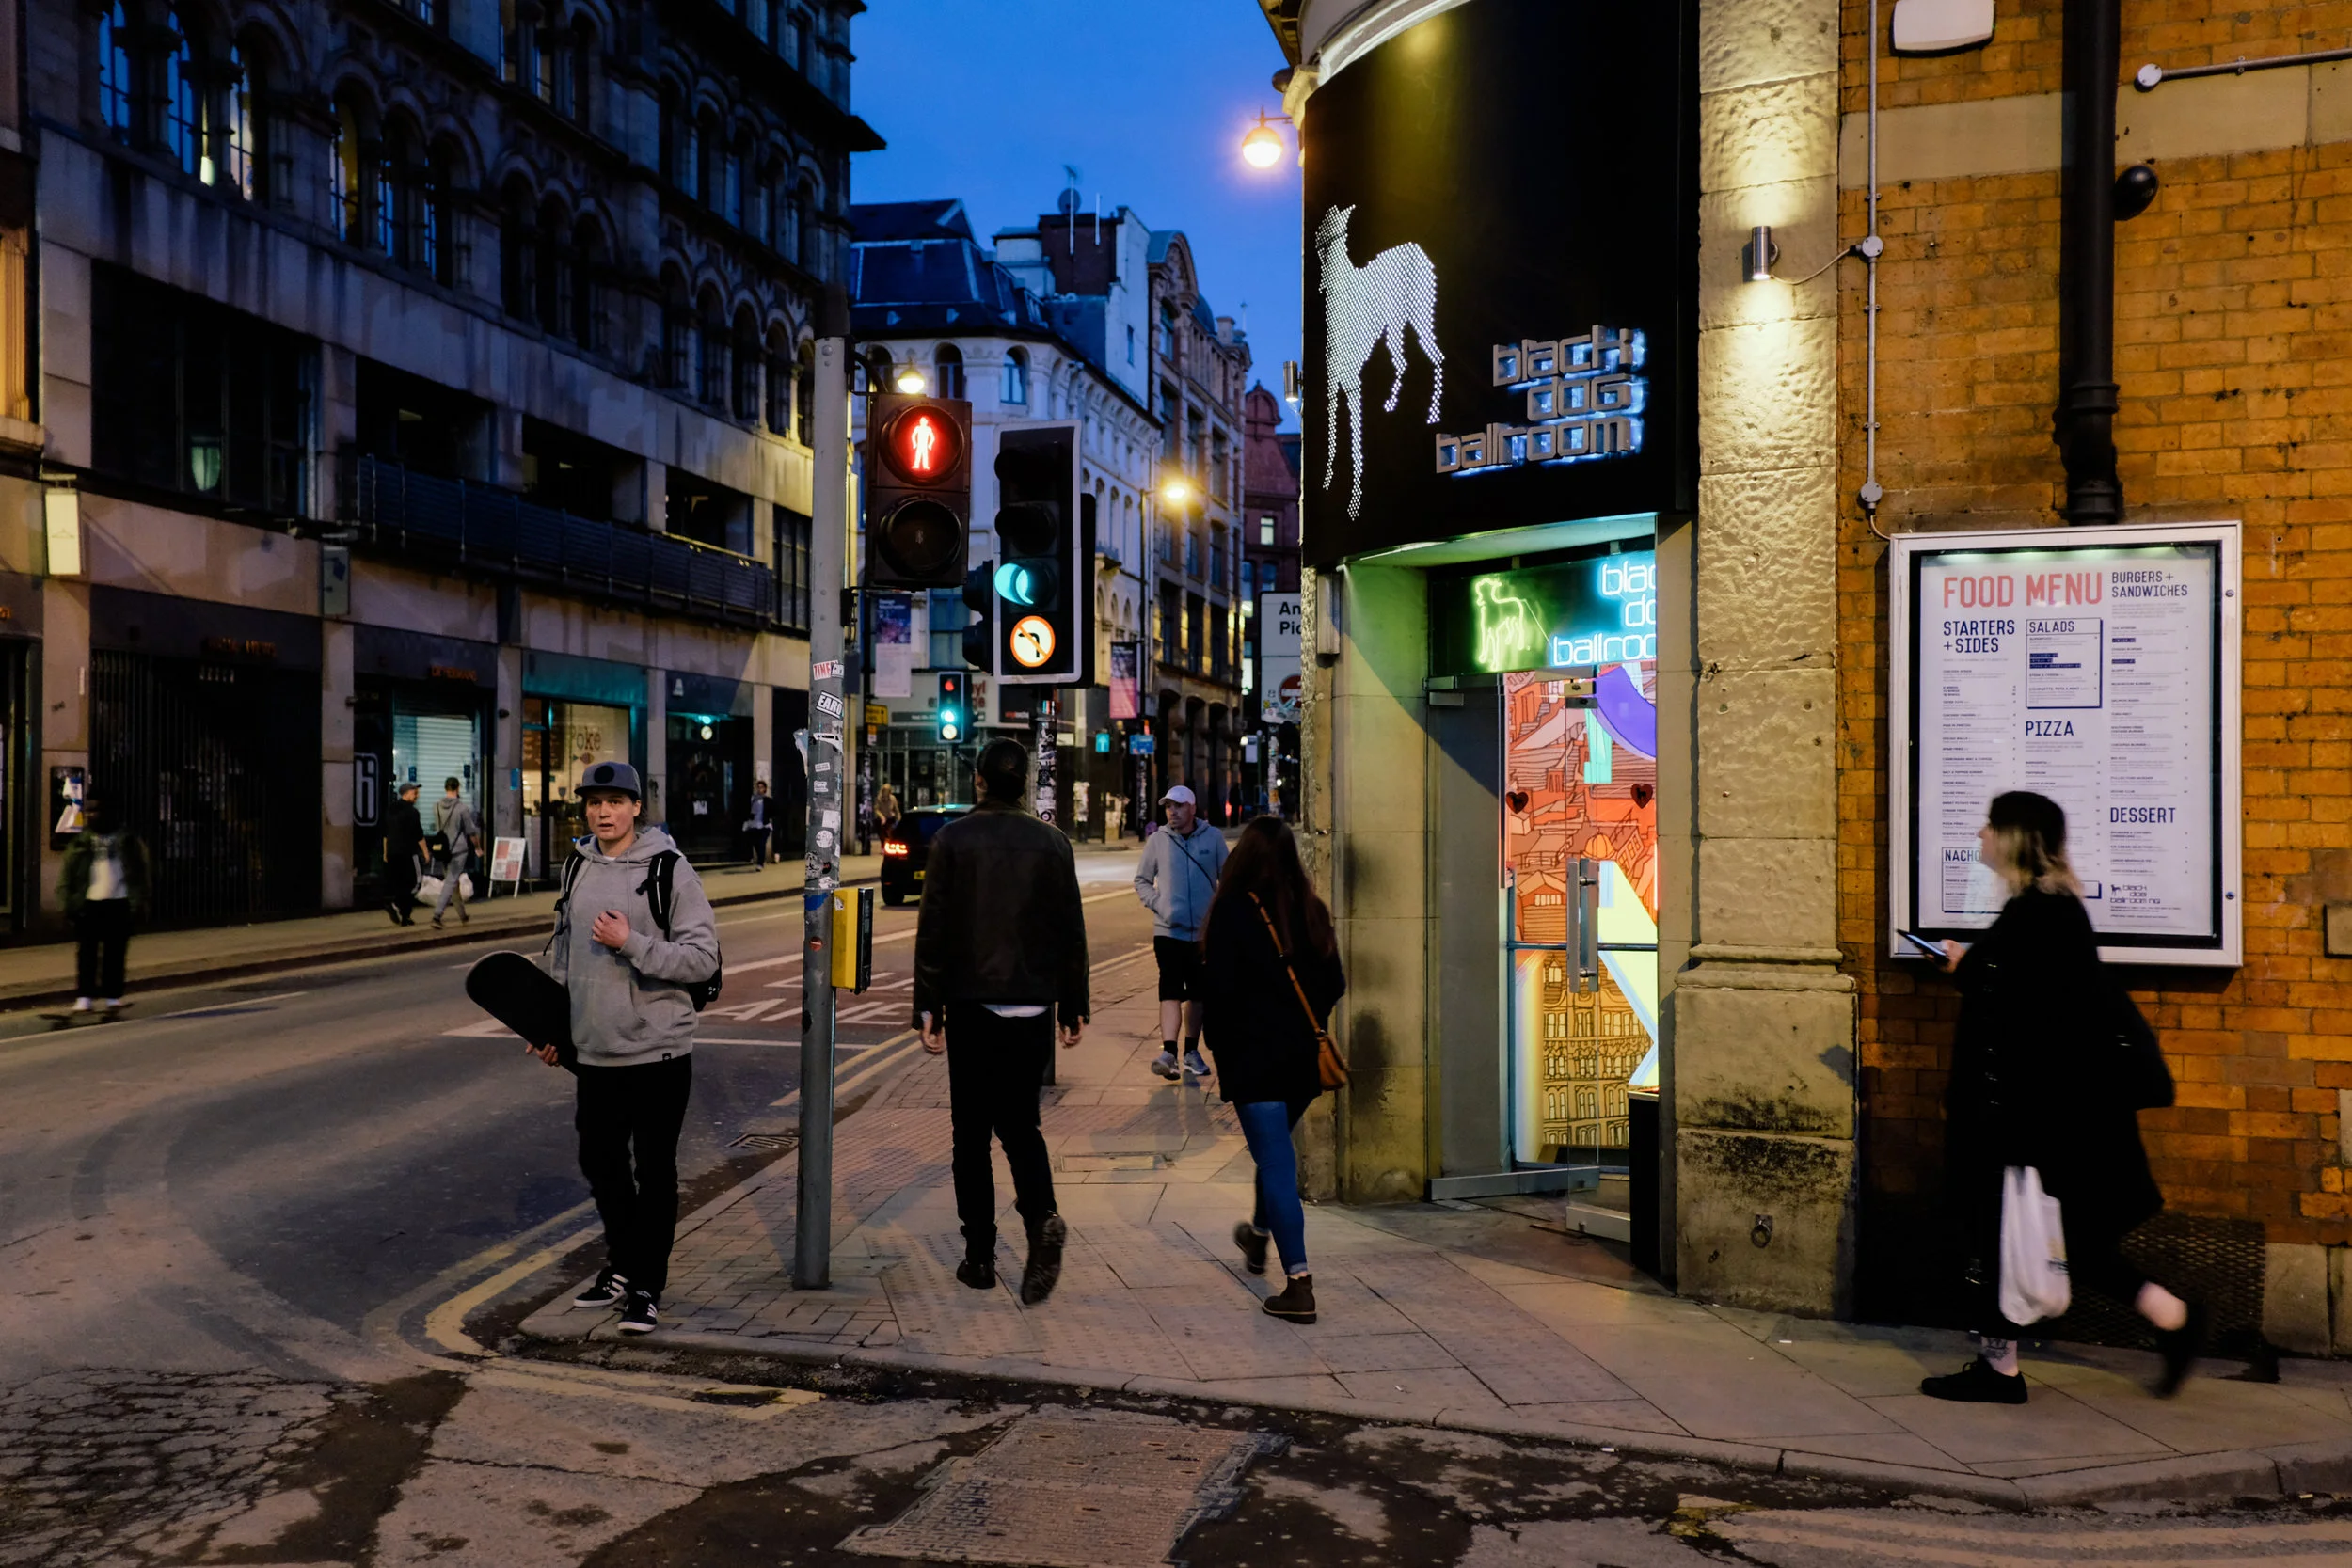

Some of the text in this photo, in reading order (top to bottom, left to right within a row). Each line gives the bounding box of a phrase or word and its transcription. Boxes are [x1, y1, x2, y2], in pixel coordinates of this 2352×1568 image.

[1493, 325, 1633, 387] black
[1436, 417, 1630, 473] ballroom
[2112, 571, 2163, 583] BURGERS
[1944, 573, 2103, 608] FOOD MENU
[2112, 584, 2188, 598] SANDWICHES
[1279, 601, 1301, 615] An
[1943, 620, 2015, 637] STARTERS
[2029, 621, 2074, 633] SALADS
[1955, 637, 1999, 654] SIDES
[2026, 721, 2074, 736] PIZZA
[2110, 807, 2176, 823] DESSERT
